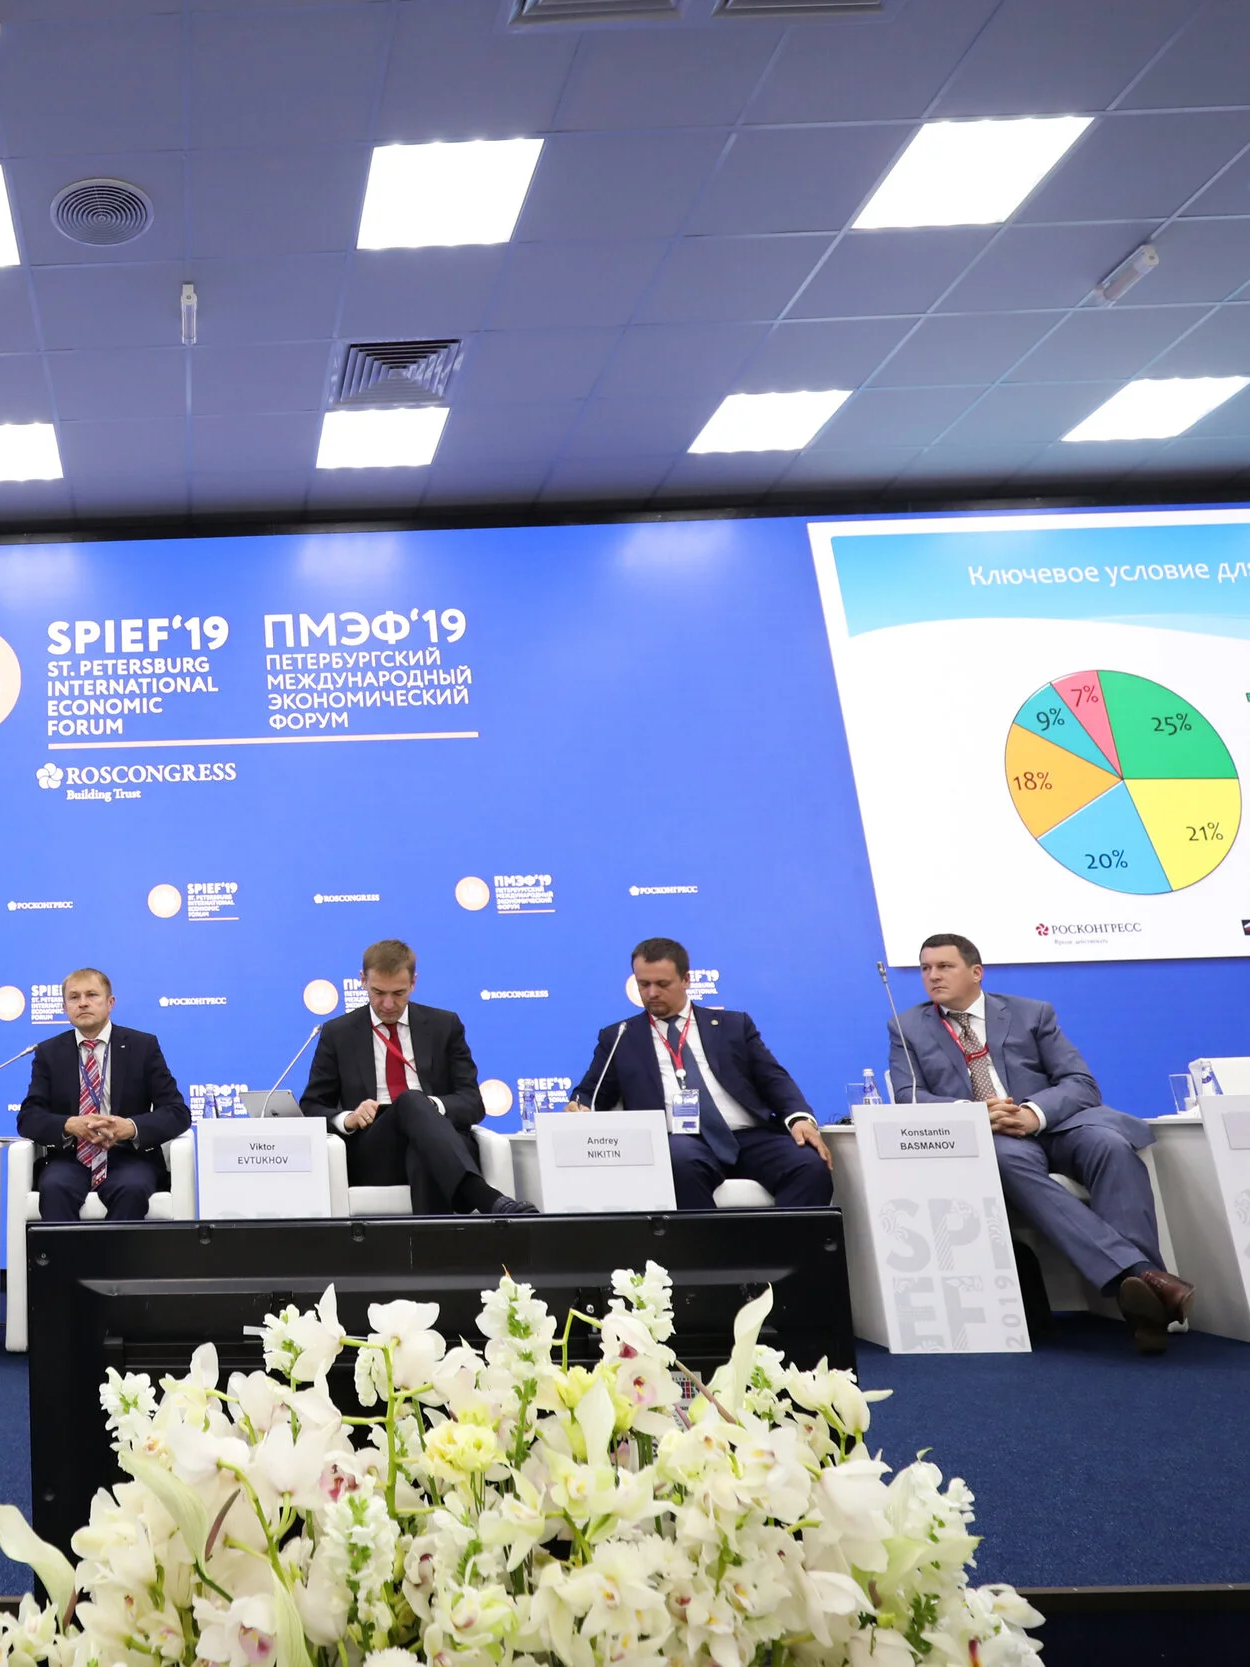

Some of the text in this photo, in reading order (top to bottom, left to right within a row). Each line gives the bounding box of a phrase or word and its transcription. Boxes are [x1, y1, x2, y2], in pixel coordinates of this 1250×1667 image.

[968, 562, 1250, 587] Ключевое условие дл
[47, 657, 210, 678] ST. PETERSBURG
[266, 647, 441, 671] ПЕТЕРБУРГСКИЙ
[47, 675, 218, 697] INTERNATIONAL
[266, 665, 473, 693] МЕЖДУНАРОДНЫЙ
[47, 696, 163, 716] ECONOMIC
[267, 686, 469, 710] ЭКОНОМИЧЕСКИЙ
[1071, 685, 1099, 708] 7%
[47, 718, 123, 736] FORUM
[269, 712, 349, 731] ФОРУМ
[1036, 708, 1065, 731] 9%
[1153, 713, 1192, 736] 25%
[66, 763, 237, 786] ROSCONGRESS
[1012, 771, 1053, 792] 18%
[66, 787, 141, 802] Building Trust
[1186, 822, 1224, 842] 21%
[1085, 849, 1128, 870] 20%
[324, 894, 380, 903] ROSCONGRESS
[640, 885, 698, 895] РОСКОНГРЕСС
[17, 901, 73, 910] РОСКОНГРЕСС
[1052, 923, 1142, 935] РОСКОНГРЕСС
[31, 984, 63, 997] SPIE
[491, 990, 549, 999] ROSCONGRESS
[169, 997, 227, 1006] РОСКОНГРЕСС
[900, 1127, 951, 1137] Konstantin
[249, 1142, 276, 1153] Viktor
[586, 1136, 619, 1148] Andrey
[899, 1140, 956, 1151] BASMANOV
[237, 1155, 289, 1166] EVTUKHOV
[587, 1149, 621, 1160] NIKITIN
[994, 1276, 1027, 1349] 2019
